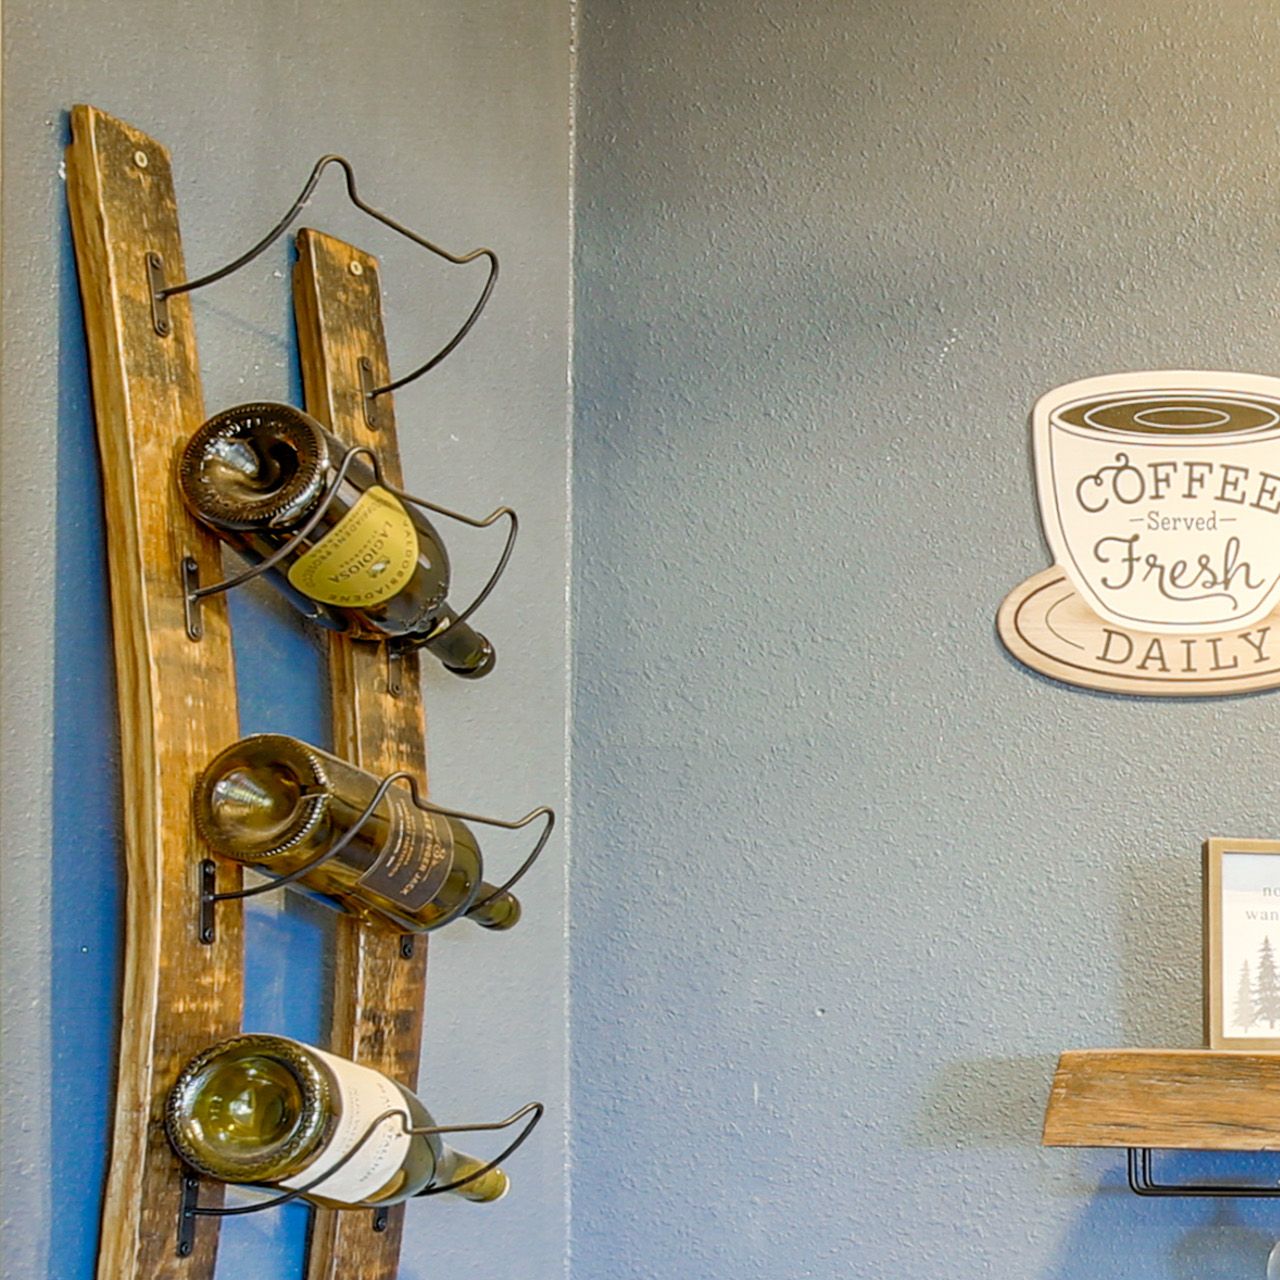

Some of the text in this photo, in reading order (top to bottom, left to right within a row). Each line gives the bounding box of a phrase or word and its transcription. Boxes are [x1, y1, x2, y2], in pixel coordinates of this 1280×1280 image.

[1146, 510, 1218, 531] Served
[1093, 533, 1265, 611] Fresh
[1096, 626, 1272, 672] DAILY
